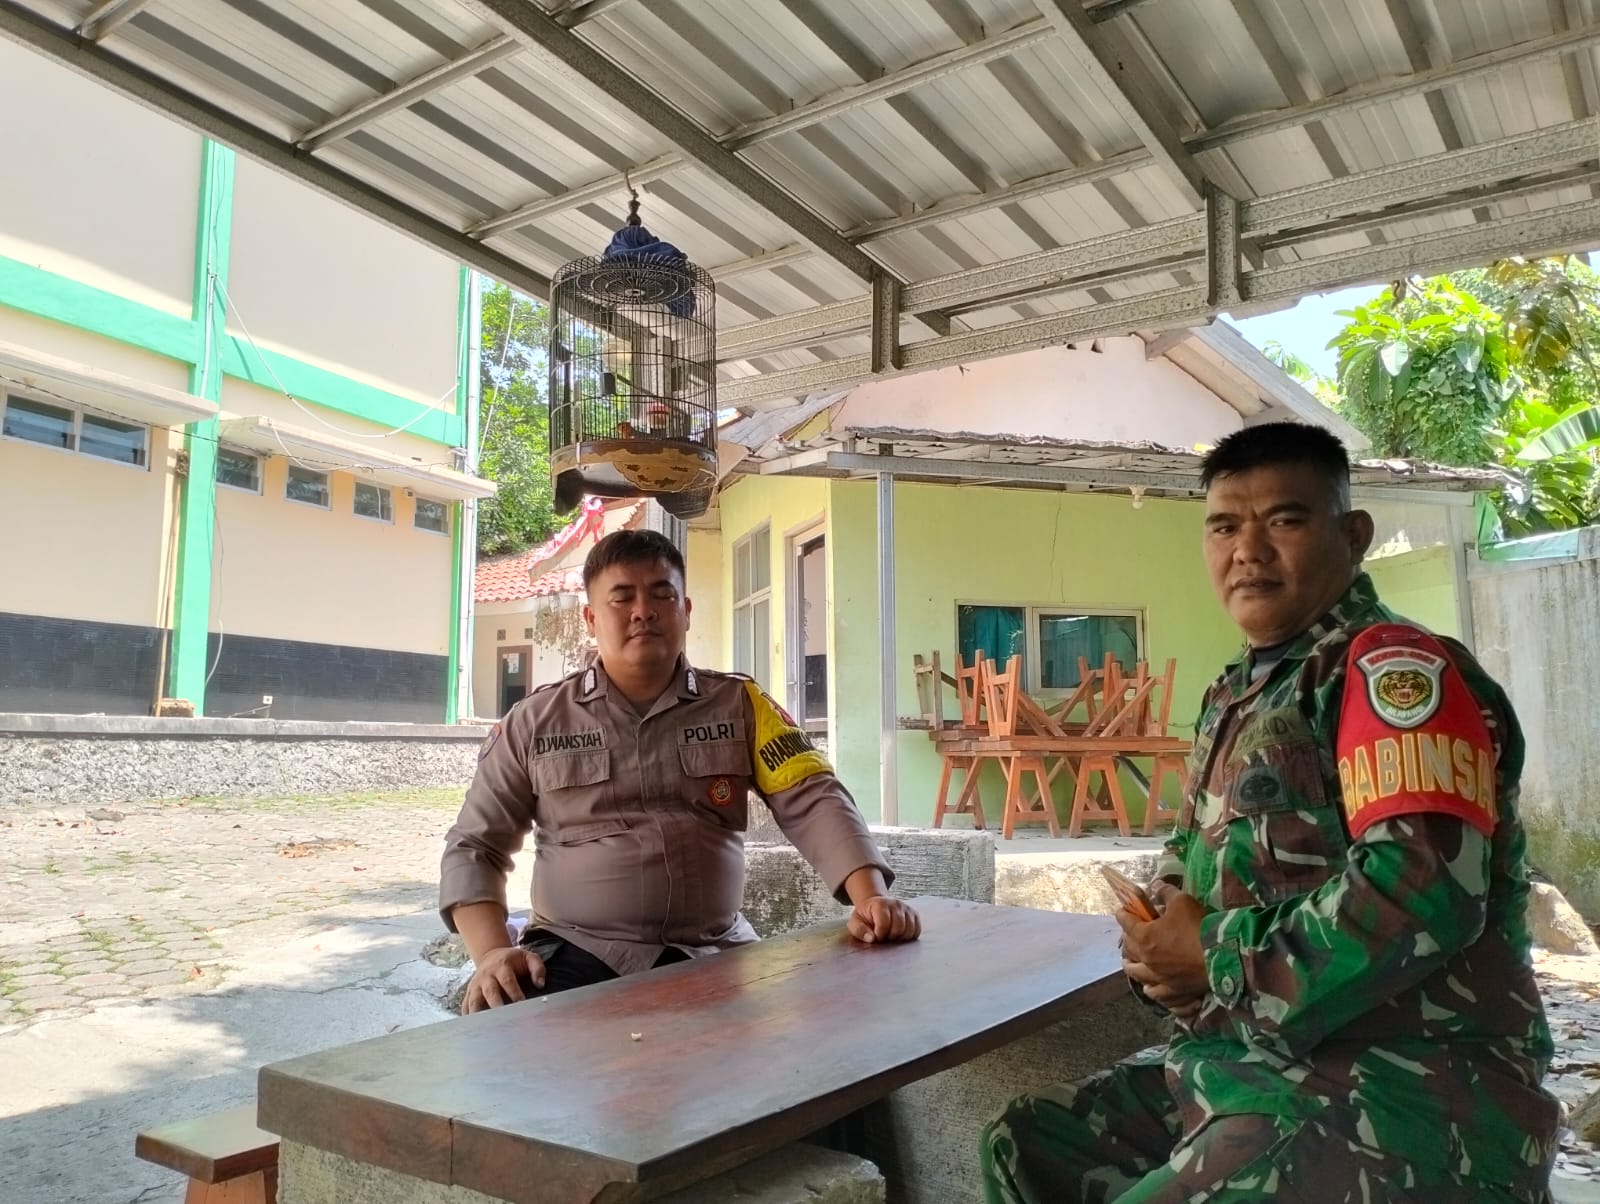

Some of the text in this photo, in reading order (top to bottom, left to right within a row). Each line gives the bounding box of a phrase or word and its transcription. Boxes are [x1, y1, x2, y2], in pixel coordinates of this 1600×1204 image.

[536, 731, 602, 755] D.WANSYAH
[683, 723, 735, 744] POLRI
[1338, 732, 1497, 821] BABINSA
